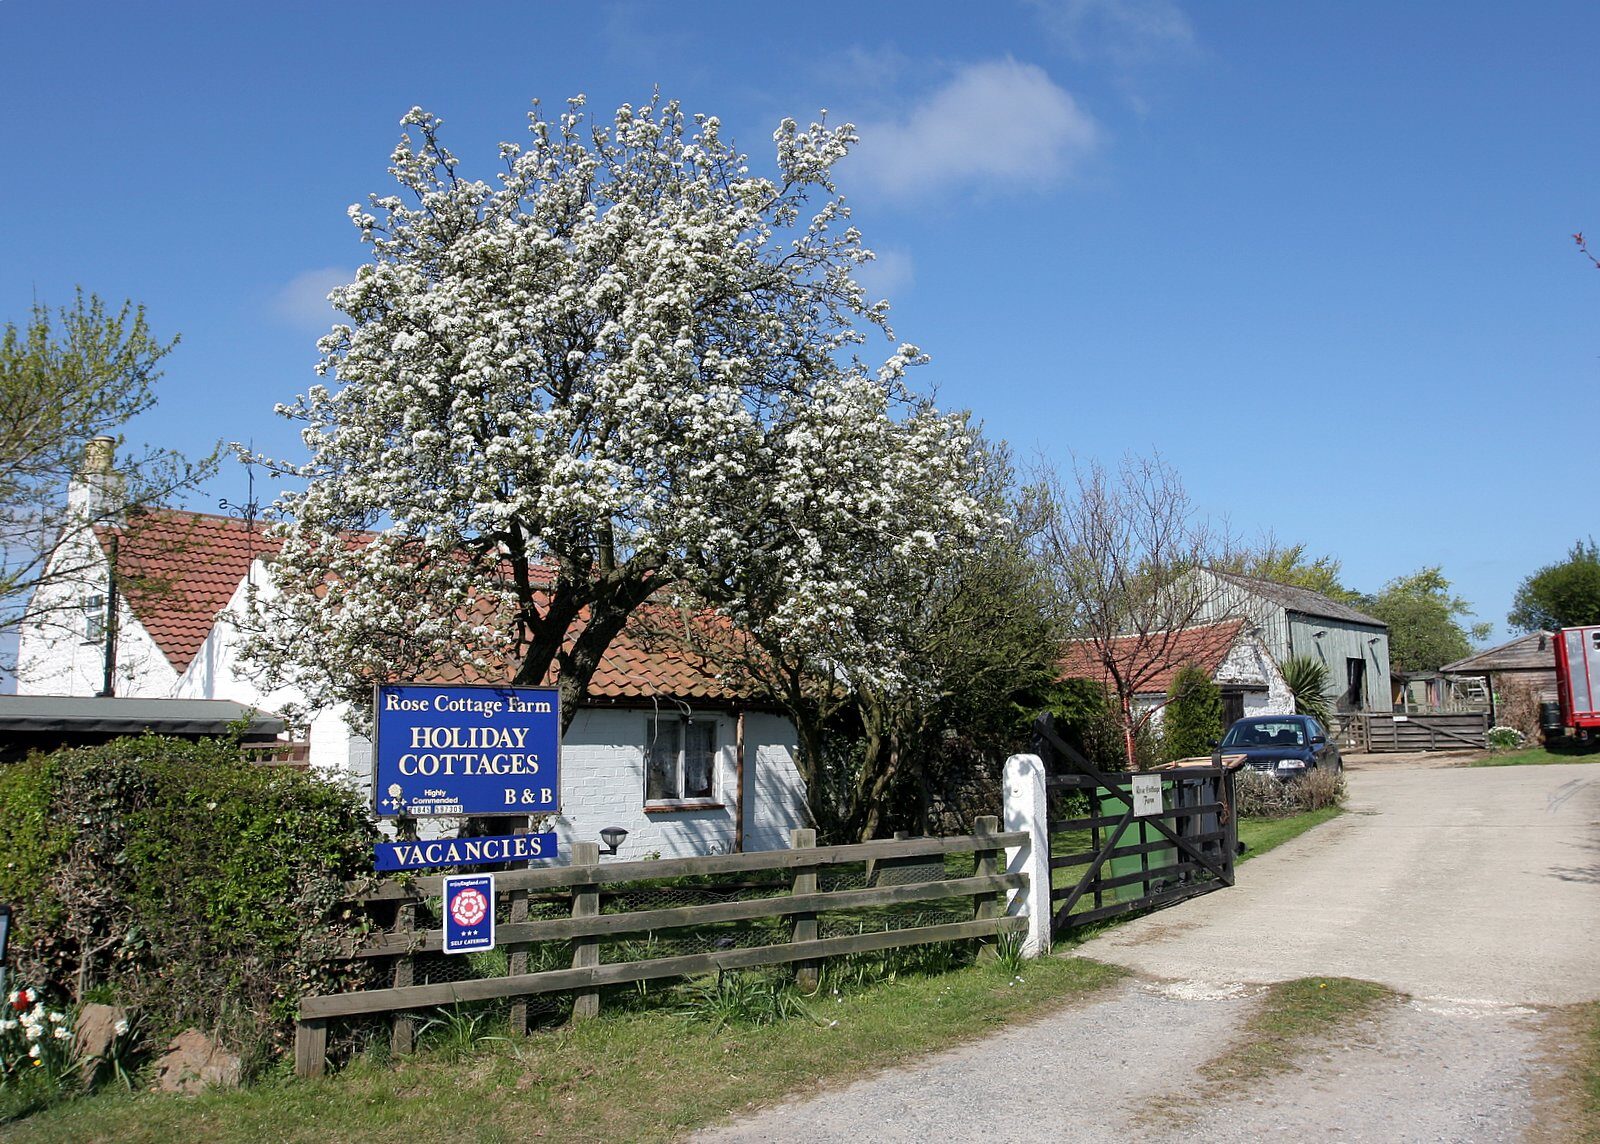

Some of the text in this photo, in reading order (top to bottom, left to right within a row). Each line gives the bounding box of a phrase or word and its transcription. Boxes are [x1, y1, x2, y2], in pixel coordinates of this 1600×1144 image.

[385, 694, 552, 718] Rose Cottage Farm
[410, 727, 530, 749] HOLIDAY
[398, 754, 540, 776] COTTAGES
[412, 797, 459, 805] Commended
[424, 789, 447, 798] Highly
[504, 787, 553, 804] B & B
[393, 837, 542, 866] VACANCIES
